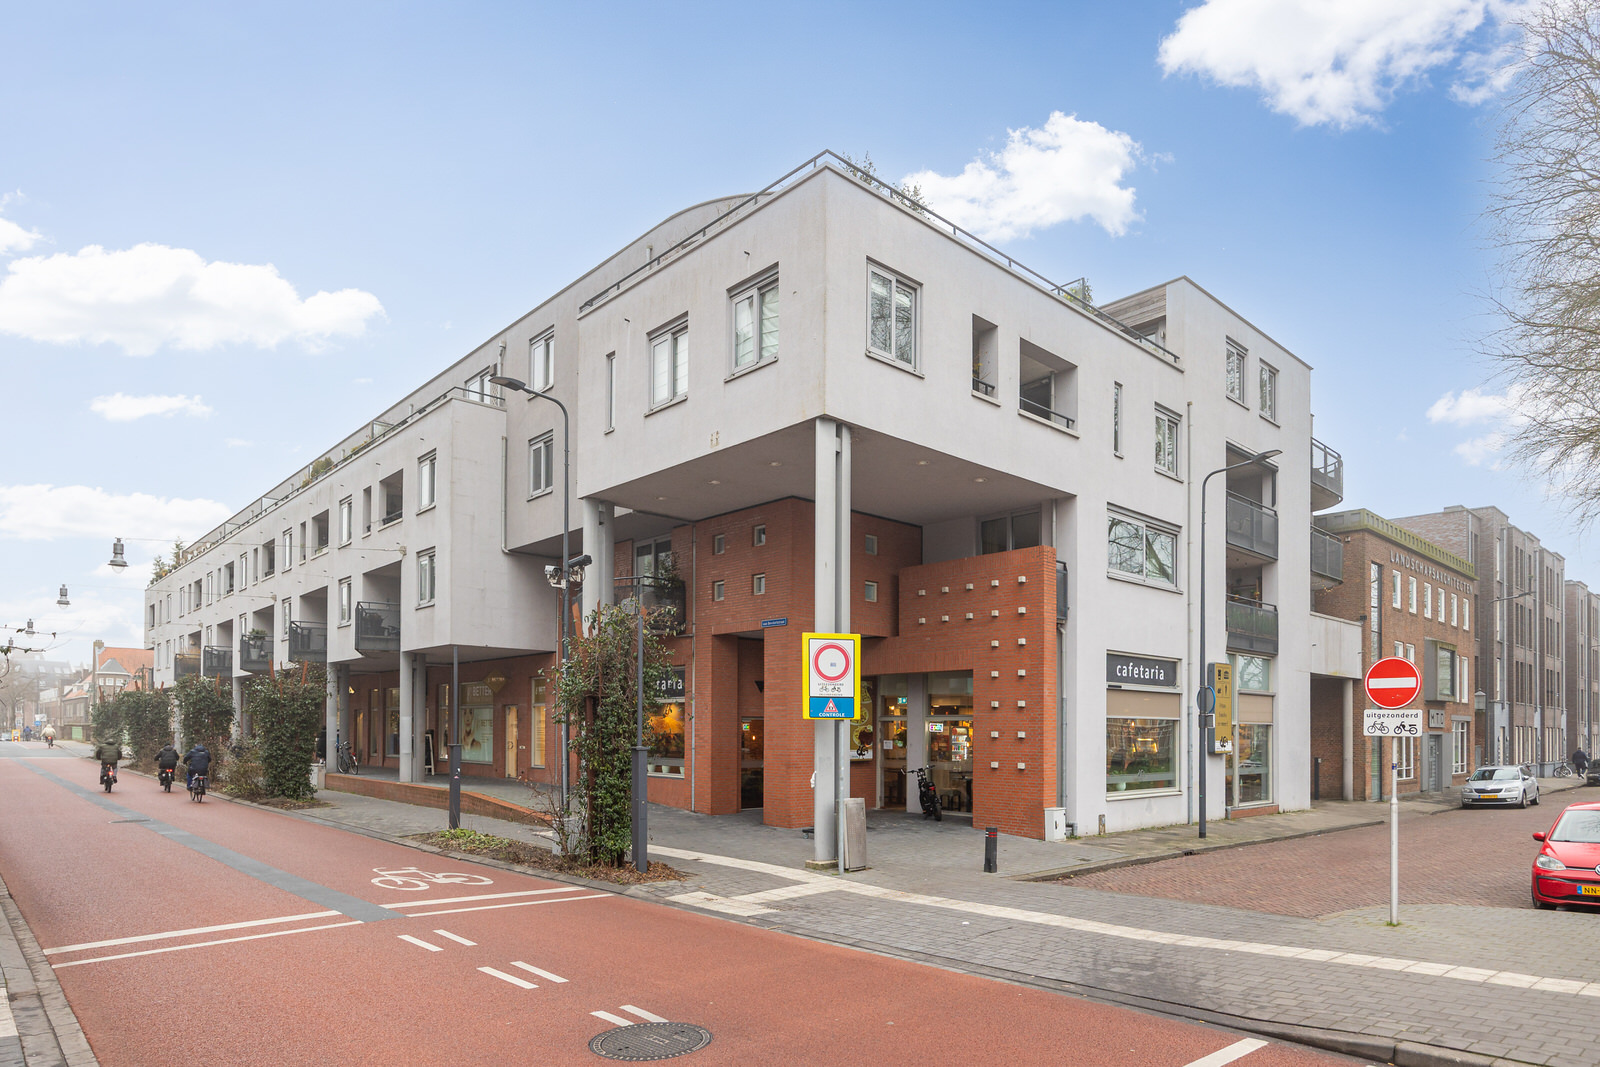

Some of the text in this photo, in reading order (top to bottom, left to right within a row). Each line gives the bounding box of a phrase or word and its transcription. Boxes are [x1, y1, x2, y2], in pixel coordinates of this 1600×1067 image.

[1390, 549, 1474, 596] LANDSCHAPSARCHITECTEN
[1116, 662, 1165, 680] cafetaria
[1366, 712, 1419, 720] uitgezonderd
